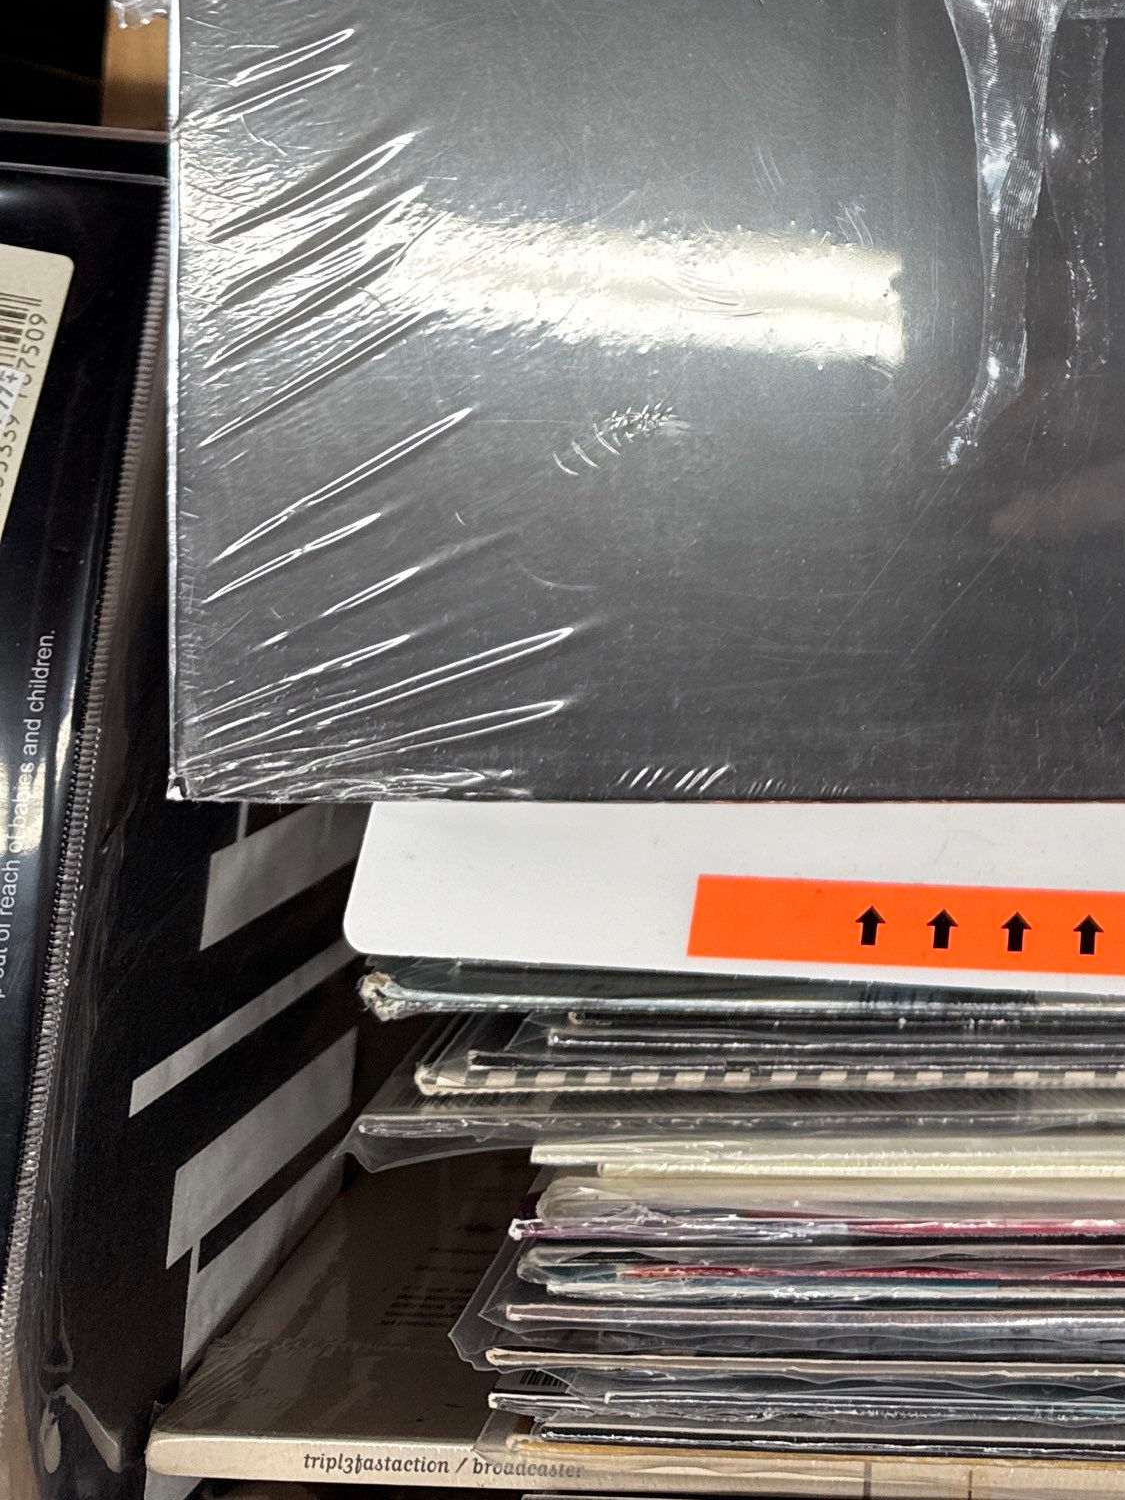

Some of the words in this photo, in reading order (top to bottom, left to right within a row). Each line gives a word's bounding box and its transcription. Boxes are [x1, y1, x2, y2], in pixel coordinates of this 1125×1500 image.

[27, 629, 56, 713] children.
[23, 718, 41, 756] and
[472, 1457, 585, 1480] broadcaster
